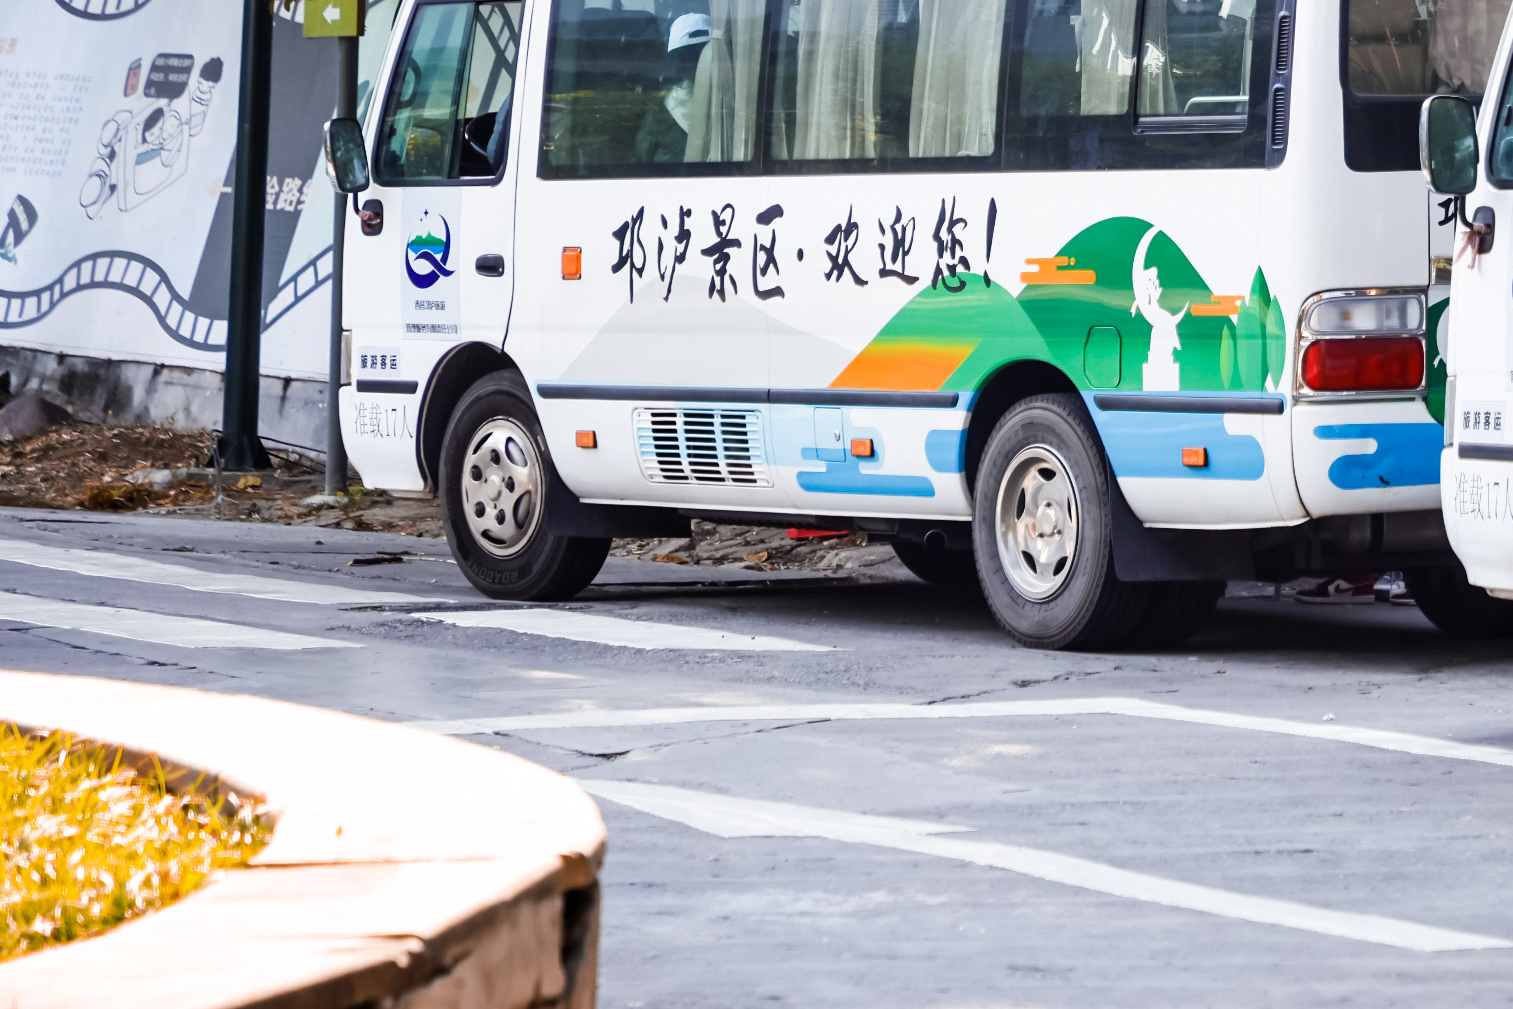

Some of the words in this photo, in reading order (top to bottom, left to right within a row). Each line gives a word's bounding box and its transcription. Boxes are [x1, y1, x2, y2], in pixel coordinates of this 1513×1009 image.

[360, 354, 398, 370] 旅游客运
[1462, 410, 1502, 431] 旅游客运
